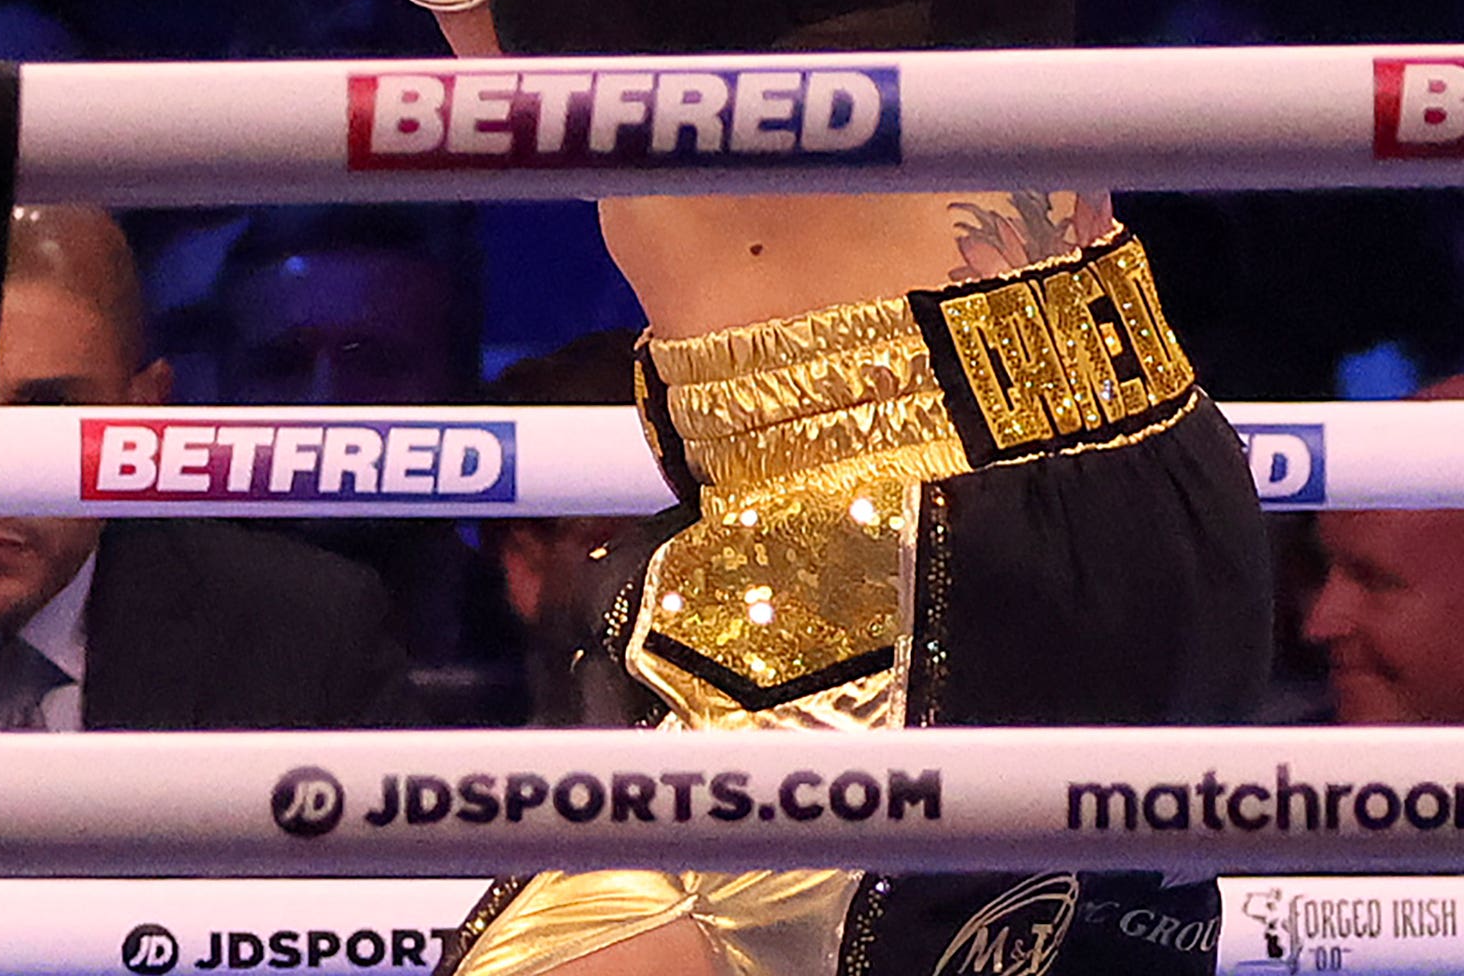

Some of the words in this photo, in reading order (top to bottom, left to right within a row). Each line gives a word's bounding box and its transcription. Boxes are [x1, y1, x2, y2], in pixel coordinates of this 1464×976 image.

[369, 70, 882, 156] BETFRED
[96, 425, 503, 495] BETFRED
[364, 770, 942, 825] JDSPORTS.COM
[1066, 761, 1464, 830] matchroo
[1392, 898, 1458, 940] IRISH
